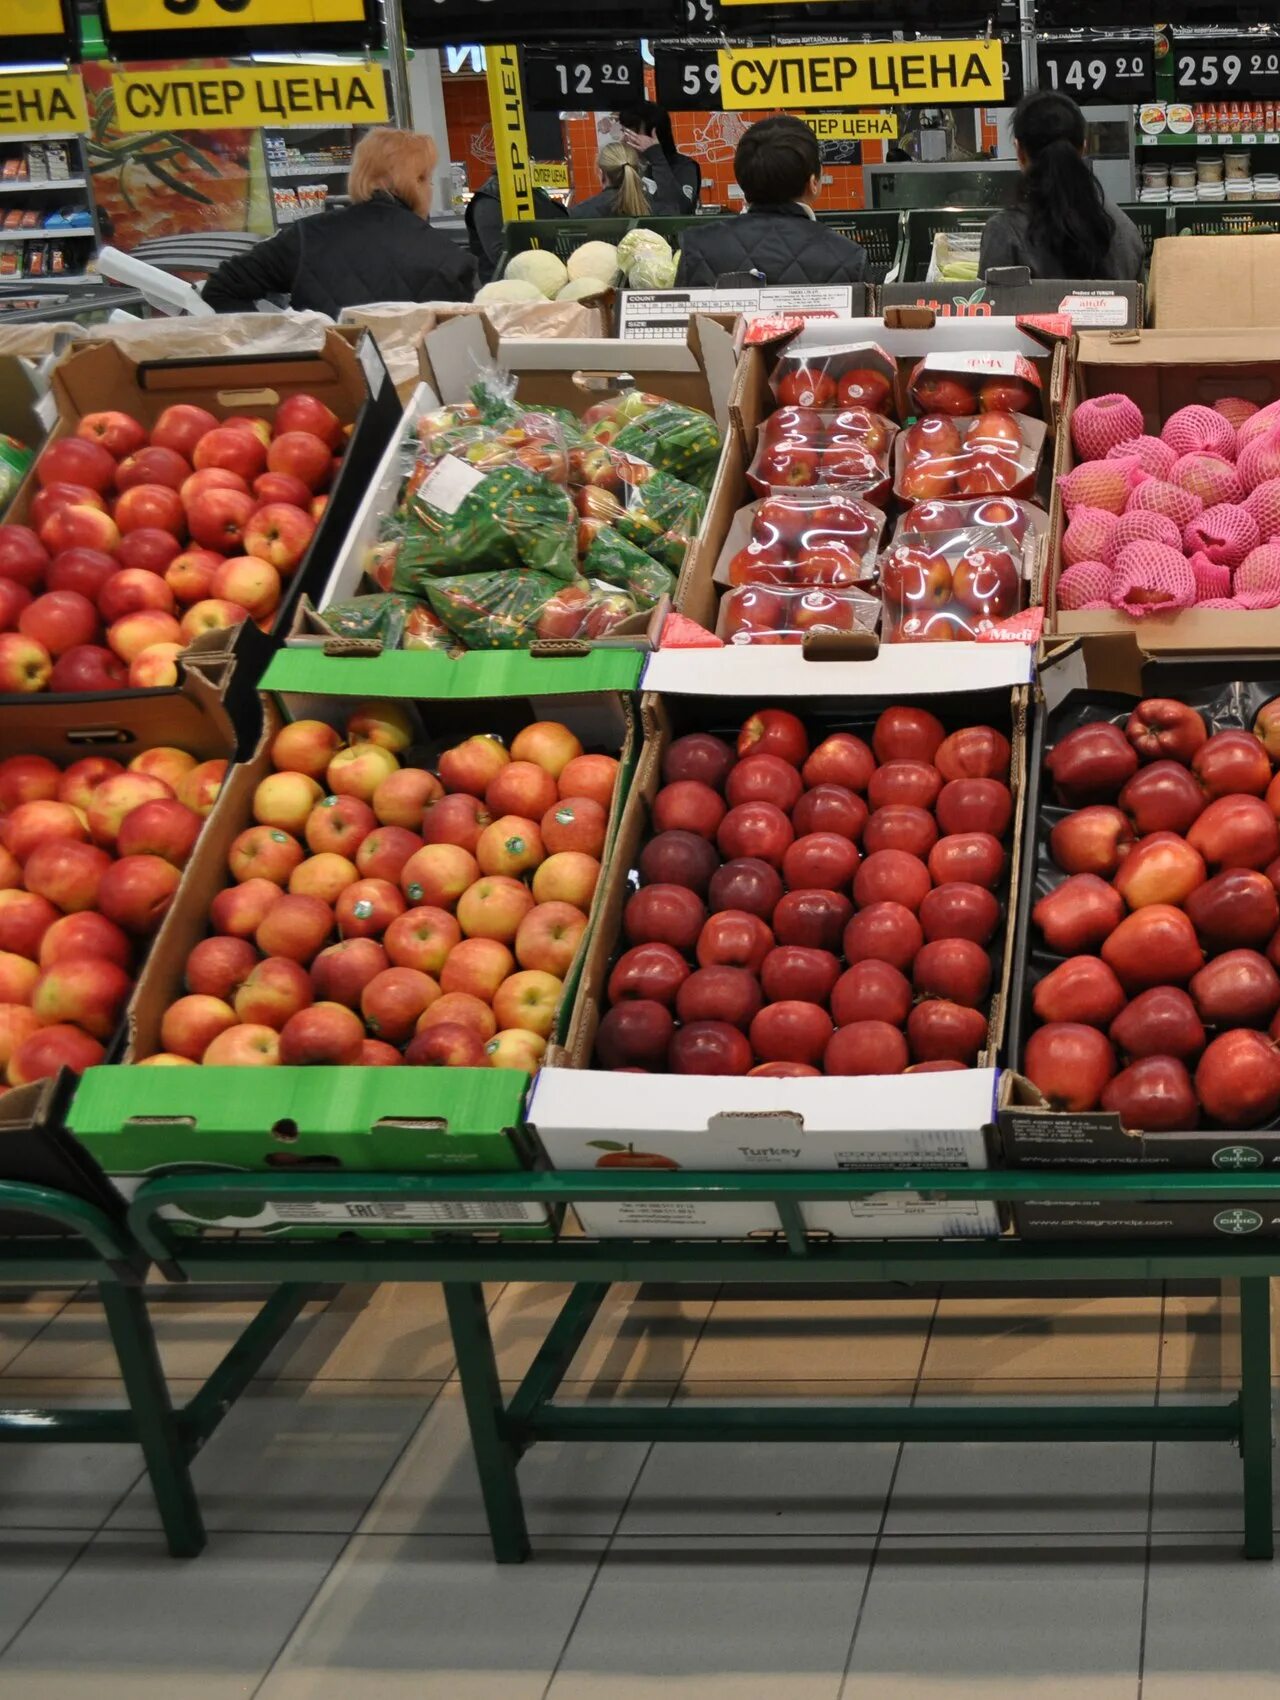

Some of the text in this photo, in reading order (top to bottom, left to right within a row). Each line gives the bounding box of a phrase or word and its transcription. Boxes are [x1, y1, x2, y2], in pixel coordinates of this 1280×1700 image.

[556, 64, 629, 95] 12 90
[682, 65, 720, 95] 59
[730, 54, 992, 96] СУПЕР ЦЕНА
[1047, 57, 1143, 90] 149 90
[1178, 55, 1279, 86] 259 90
[0, 88, 76, 123] ЕНА
[126, 77, 374, 119] СУПЕР ЦЕНА
[806, 118, 893, 135] ПЕР ЦЕНА
[738, 1147, 801, 1158] Turkey
